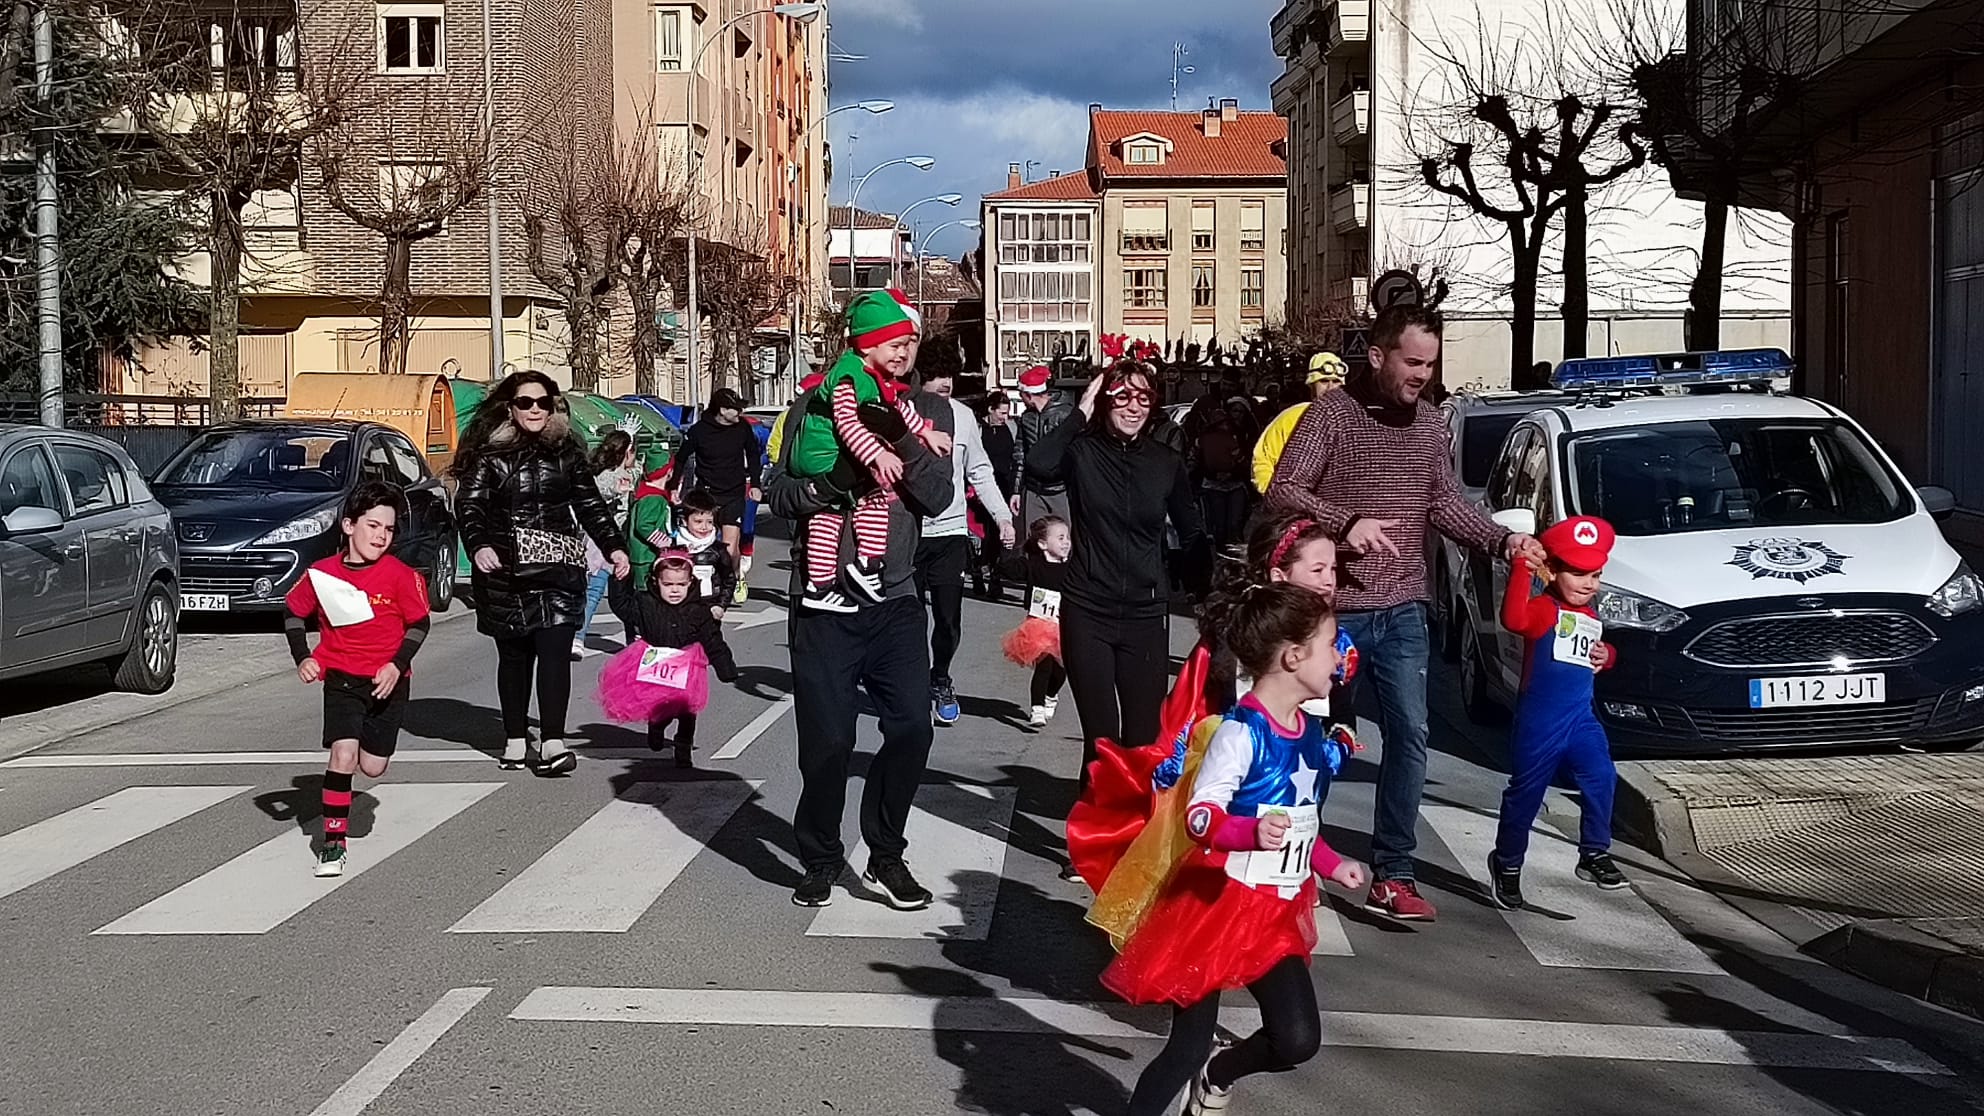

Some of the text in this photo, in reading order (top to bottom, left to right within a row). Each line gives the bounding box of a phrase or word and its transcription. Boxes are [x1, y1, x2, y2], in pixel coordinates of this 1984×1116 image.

[199, 596, 226, 609] FZH
[1041, 602, 1060, 618] 11
[1570, 632, 1596, 658] 19
[650, 660, 679, 681] 107
[1767, 676, 1879, 703] 1112 JJT
